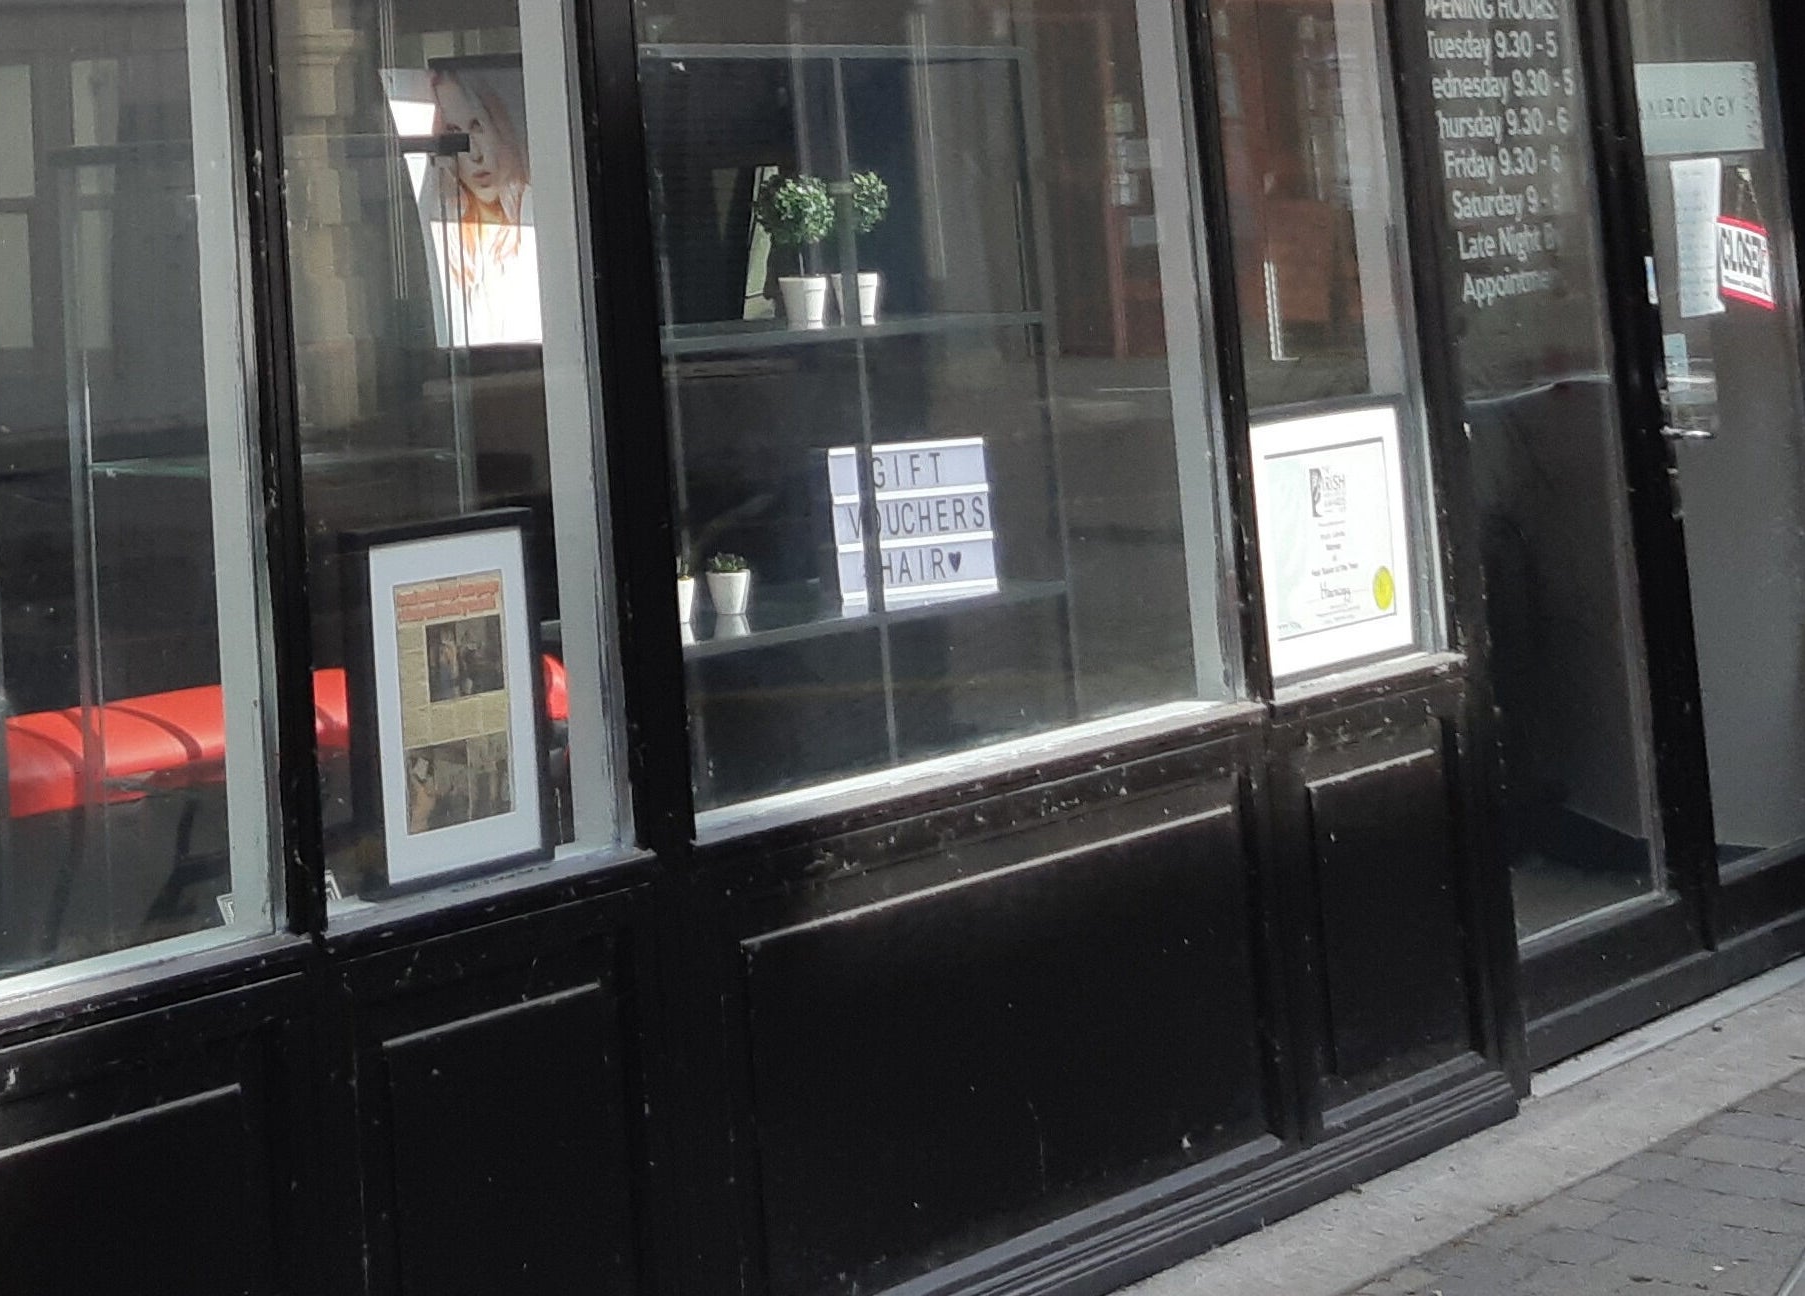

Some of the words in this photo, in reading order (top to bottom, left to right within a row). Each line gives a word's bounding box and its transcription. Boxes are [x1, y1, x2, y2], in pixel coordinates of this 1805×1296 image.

[1494, 29, 1532, 59] 9.30
[1545, 30, 1559, 58] 5
[1432, 69, 1510, 104] ednesday
[1511, 68, 1548, 97] 9.30
[1436, 109, 1505, 145] hursday
[1505, 107, 1542, 137] 9.30
[1444, 150, 1495, 184] Friday
[1498, 146, 1536, 176] 9.30
[1450, 190, 1524, 222] Saturday
[1526, 185, 1538, 214] 9
[1457, 229, 1496, 260] Late
[1498, 225, 1543, 263] Night
[871, 451, 942, 488] GIFT
